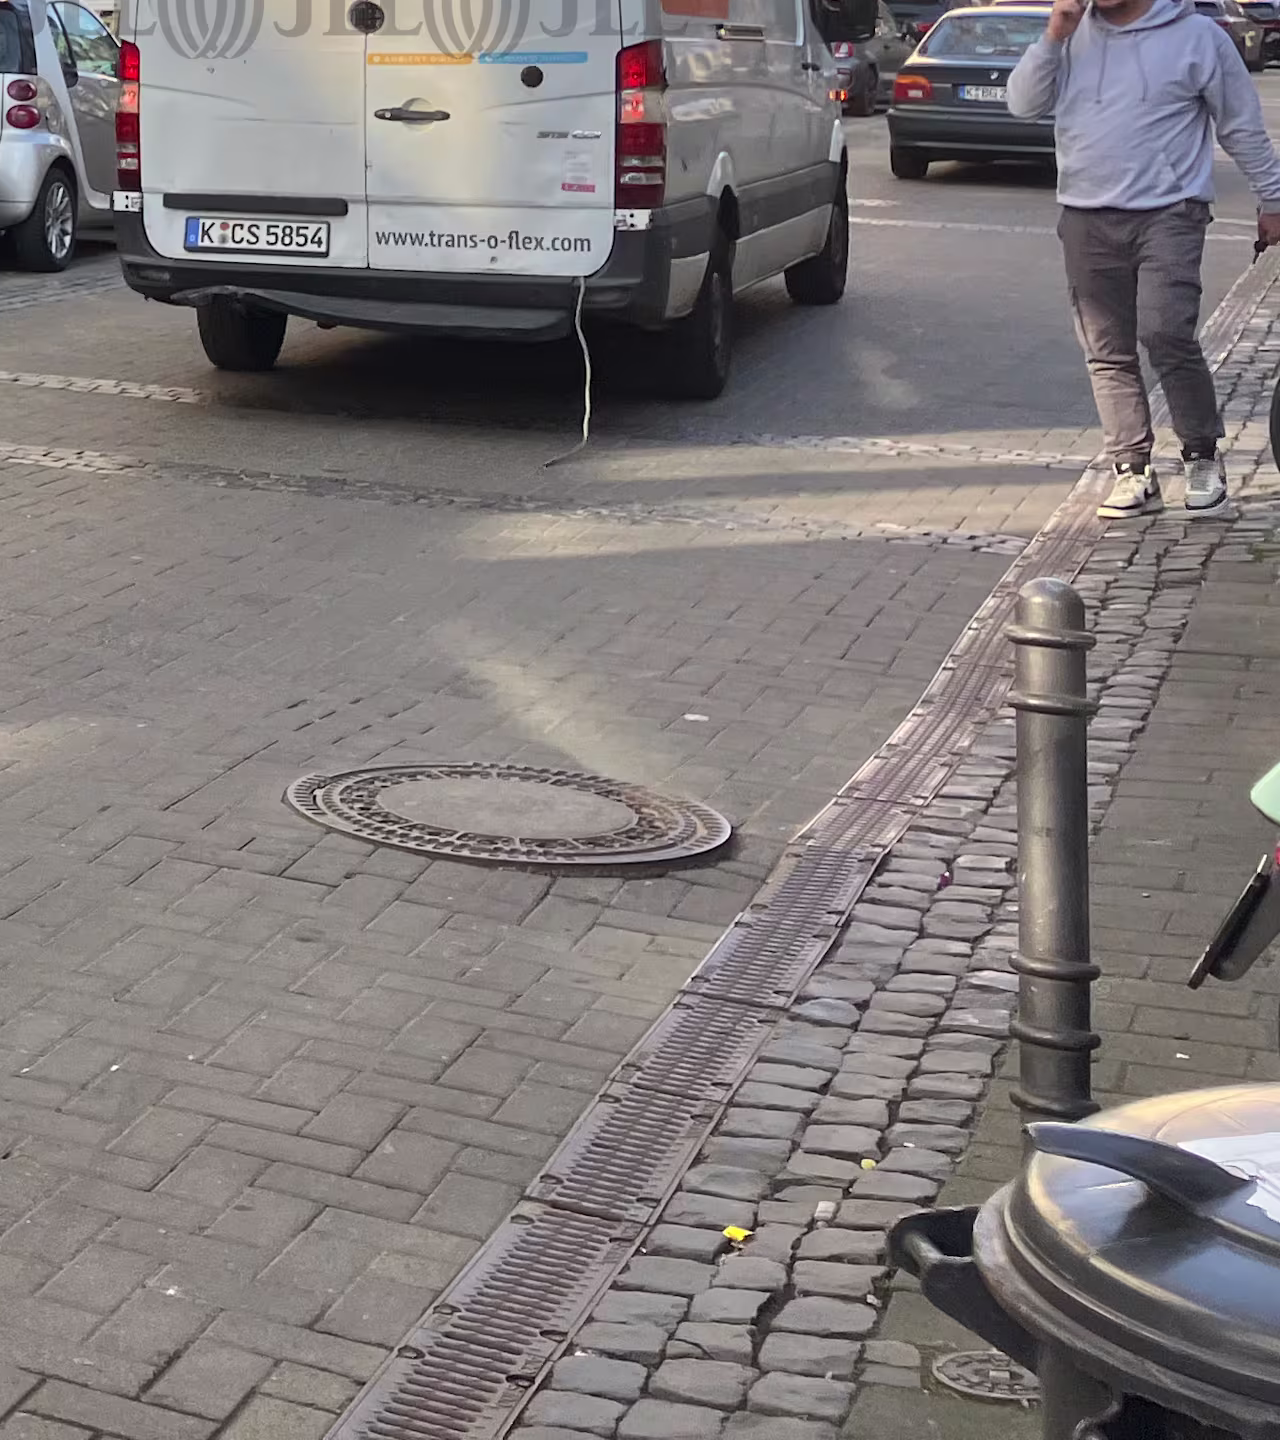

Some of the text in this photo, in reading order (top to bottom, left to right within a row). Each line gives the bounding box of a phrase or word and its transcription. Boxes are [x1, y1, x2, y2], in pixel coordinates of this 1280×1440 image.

[200, 221, 324, 249] K CS 5854
[374, 226, 592, 254] www.trans-o-flex.com
